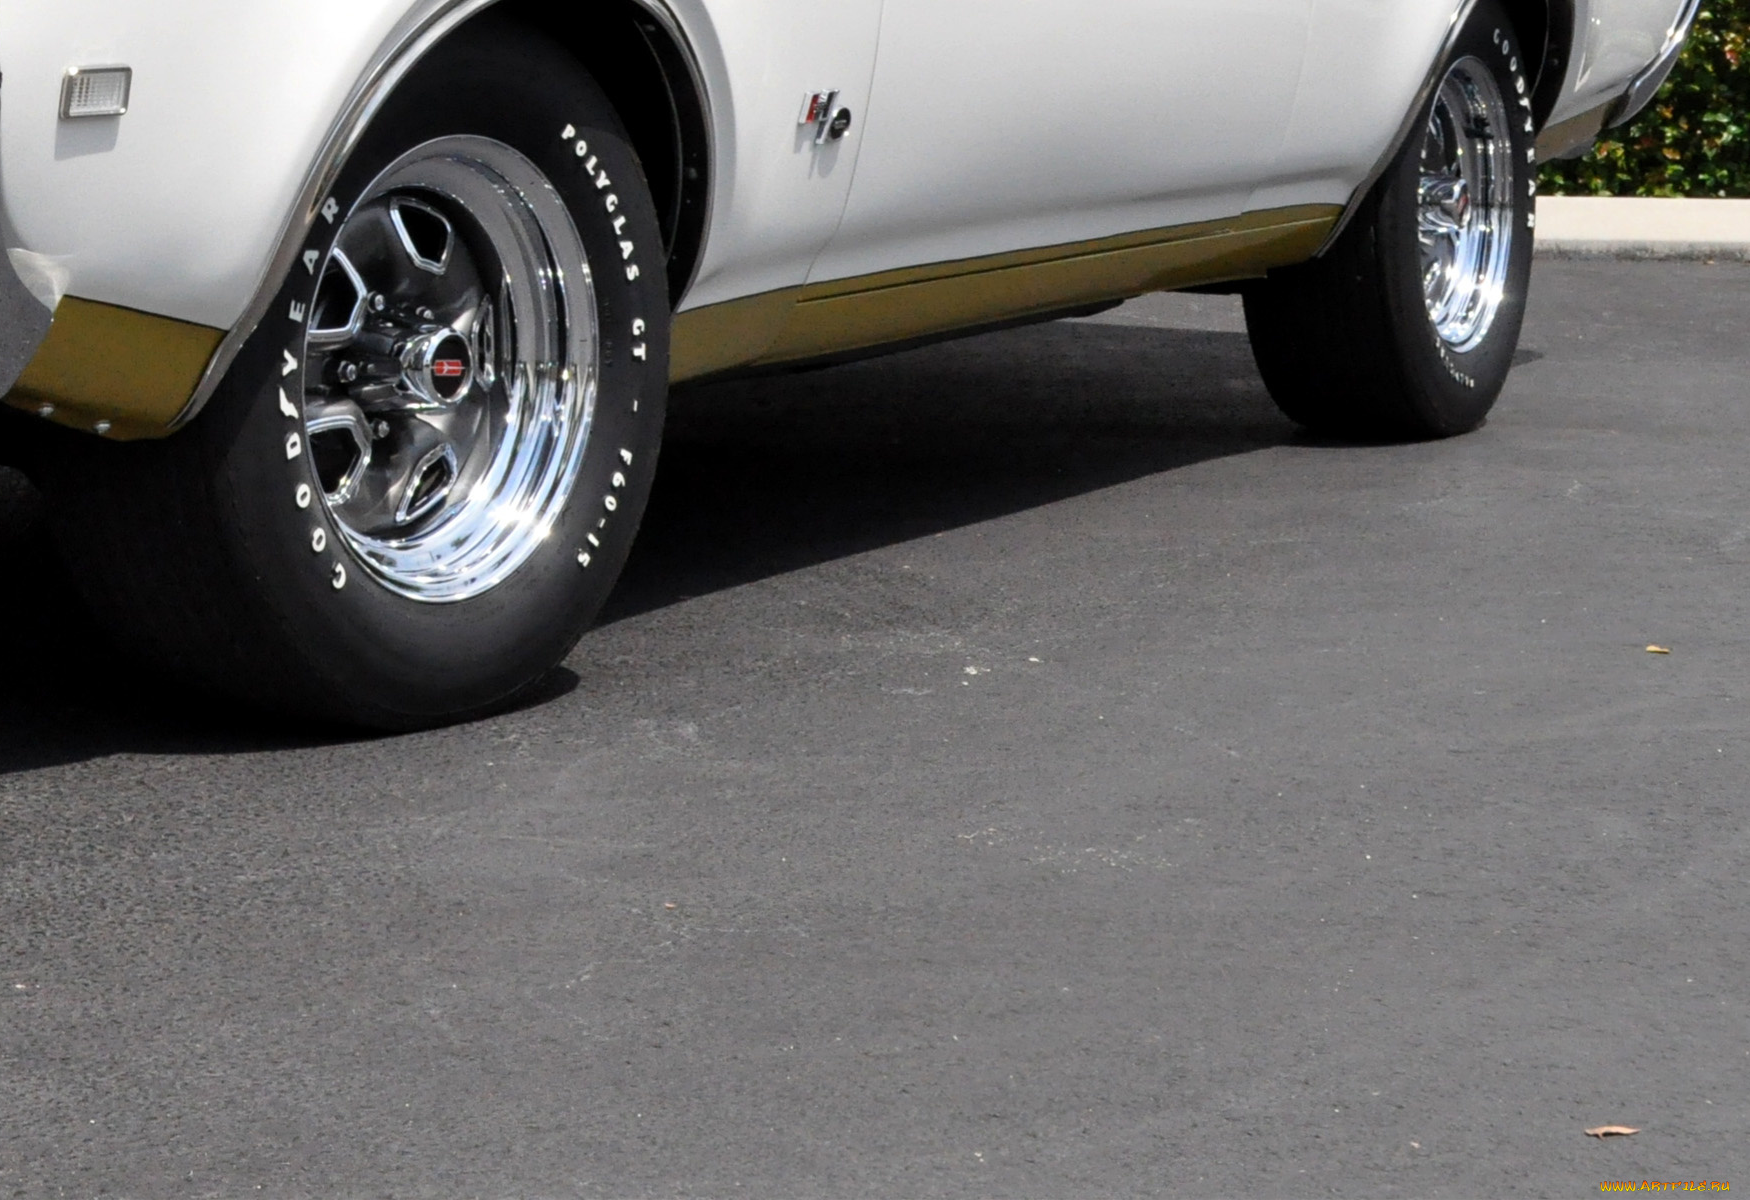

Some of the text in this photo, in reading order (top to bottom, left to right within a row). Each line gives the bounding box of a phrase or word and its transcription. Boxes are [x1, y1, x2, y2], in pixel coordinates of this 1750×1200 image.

[561, 123, 640, 282] POLYGLAS
[279, 196, 347, 590] GOODYEAR
[632, 318, 647, 361] GT
[577, 448, 633, 568] F60-15
